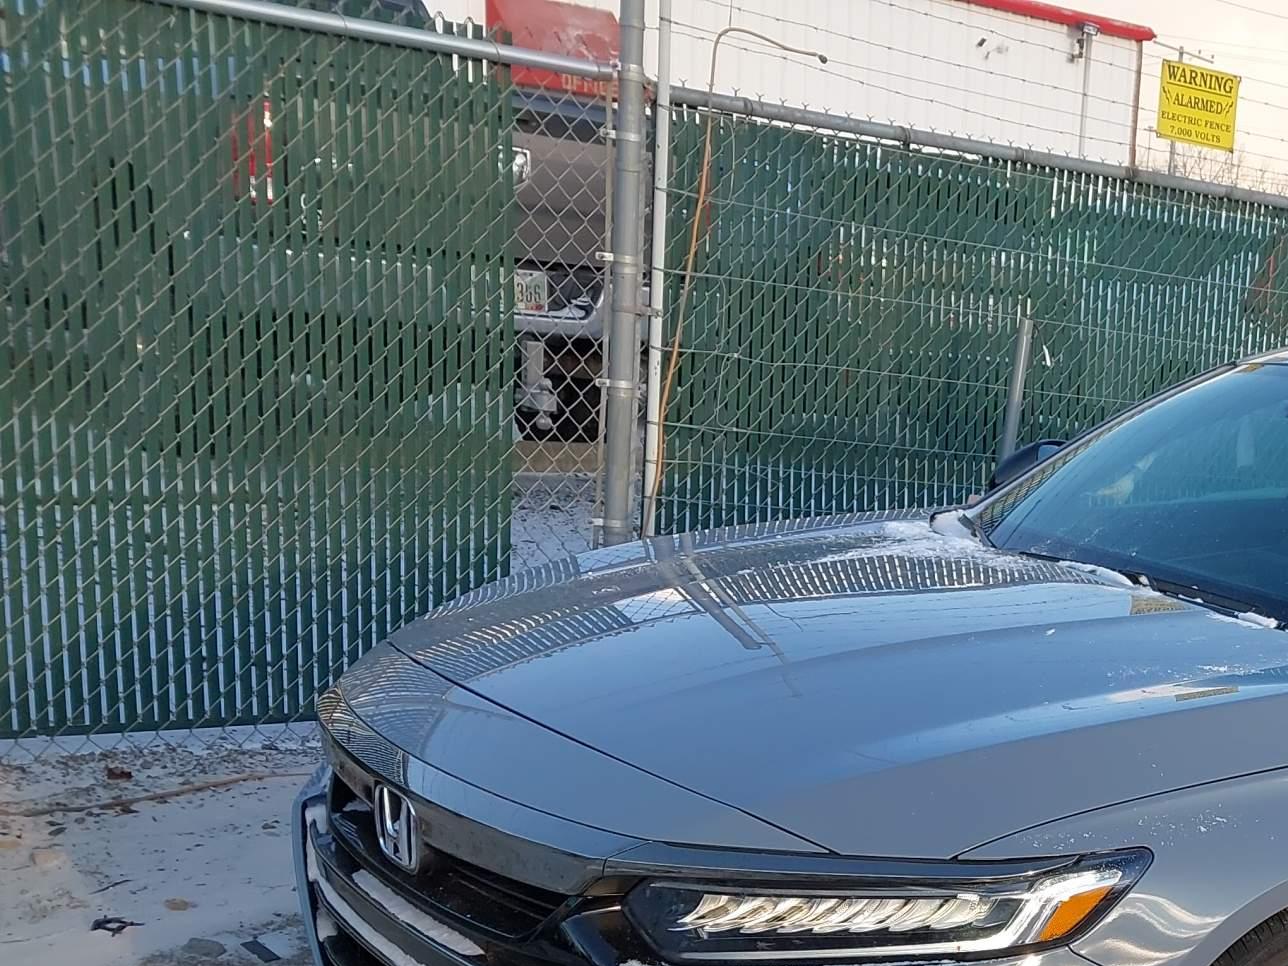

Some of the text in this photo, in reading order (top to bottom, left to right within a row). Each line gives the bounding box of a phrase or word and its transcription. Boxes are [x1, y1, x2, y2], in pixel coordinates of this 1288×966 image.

[1167, 64, 1234, 93] WARNING
[1173, 92, 1223, 115] ALARMED
[1161, 111, 1232, 133] ELECTRIC FENCE
[1194, 130, 1221, 143] VOLTS
